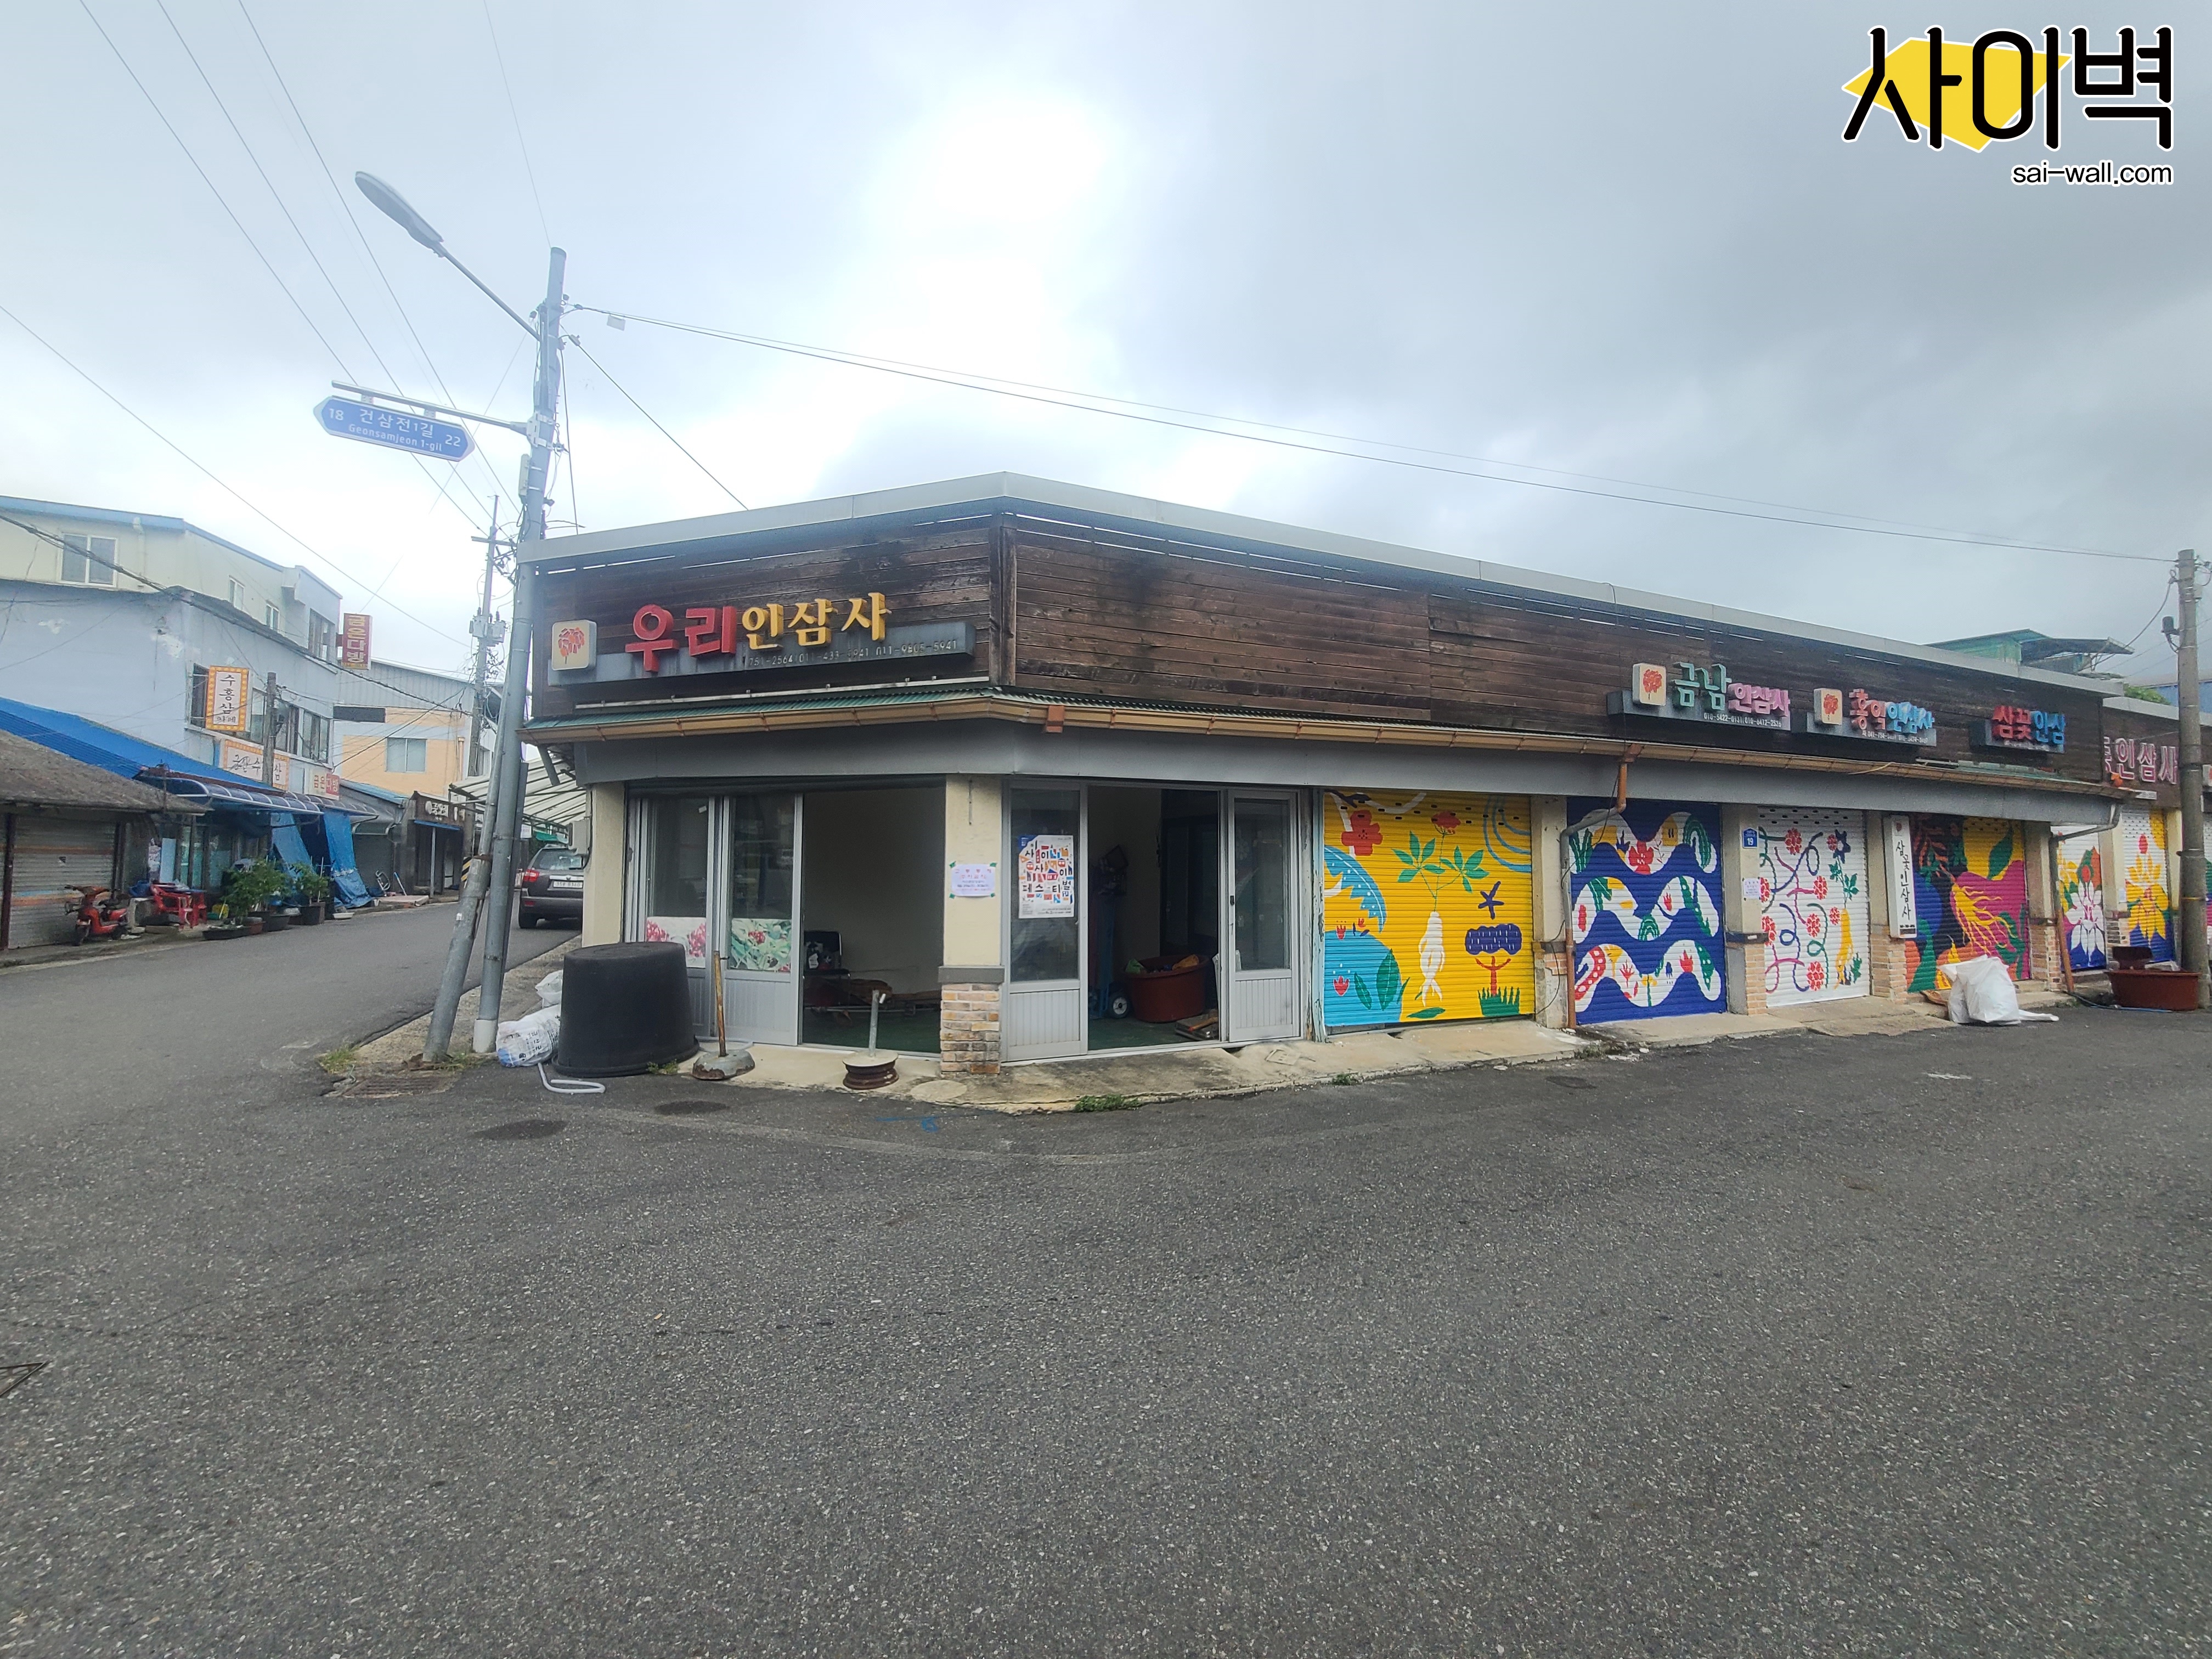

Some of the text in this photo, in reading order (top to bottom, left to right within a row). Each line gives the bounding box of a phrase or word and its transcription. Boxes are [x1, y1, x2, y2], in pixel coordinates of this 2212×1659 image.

[329, 408, 344, 421] 18
[445, 434, 461, 447] 22
[349, 424, 442, 452] Geonsamjeon 1-gil
[1747, 837, 1753, 845] 19
